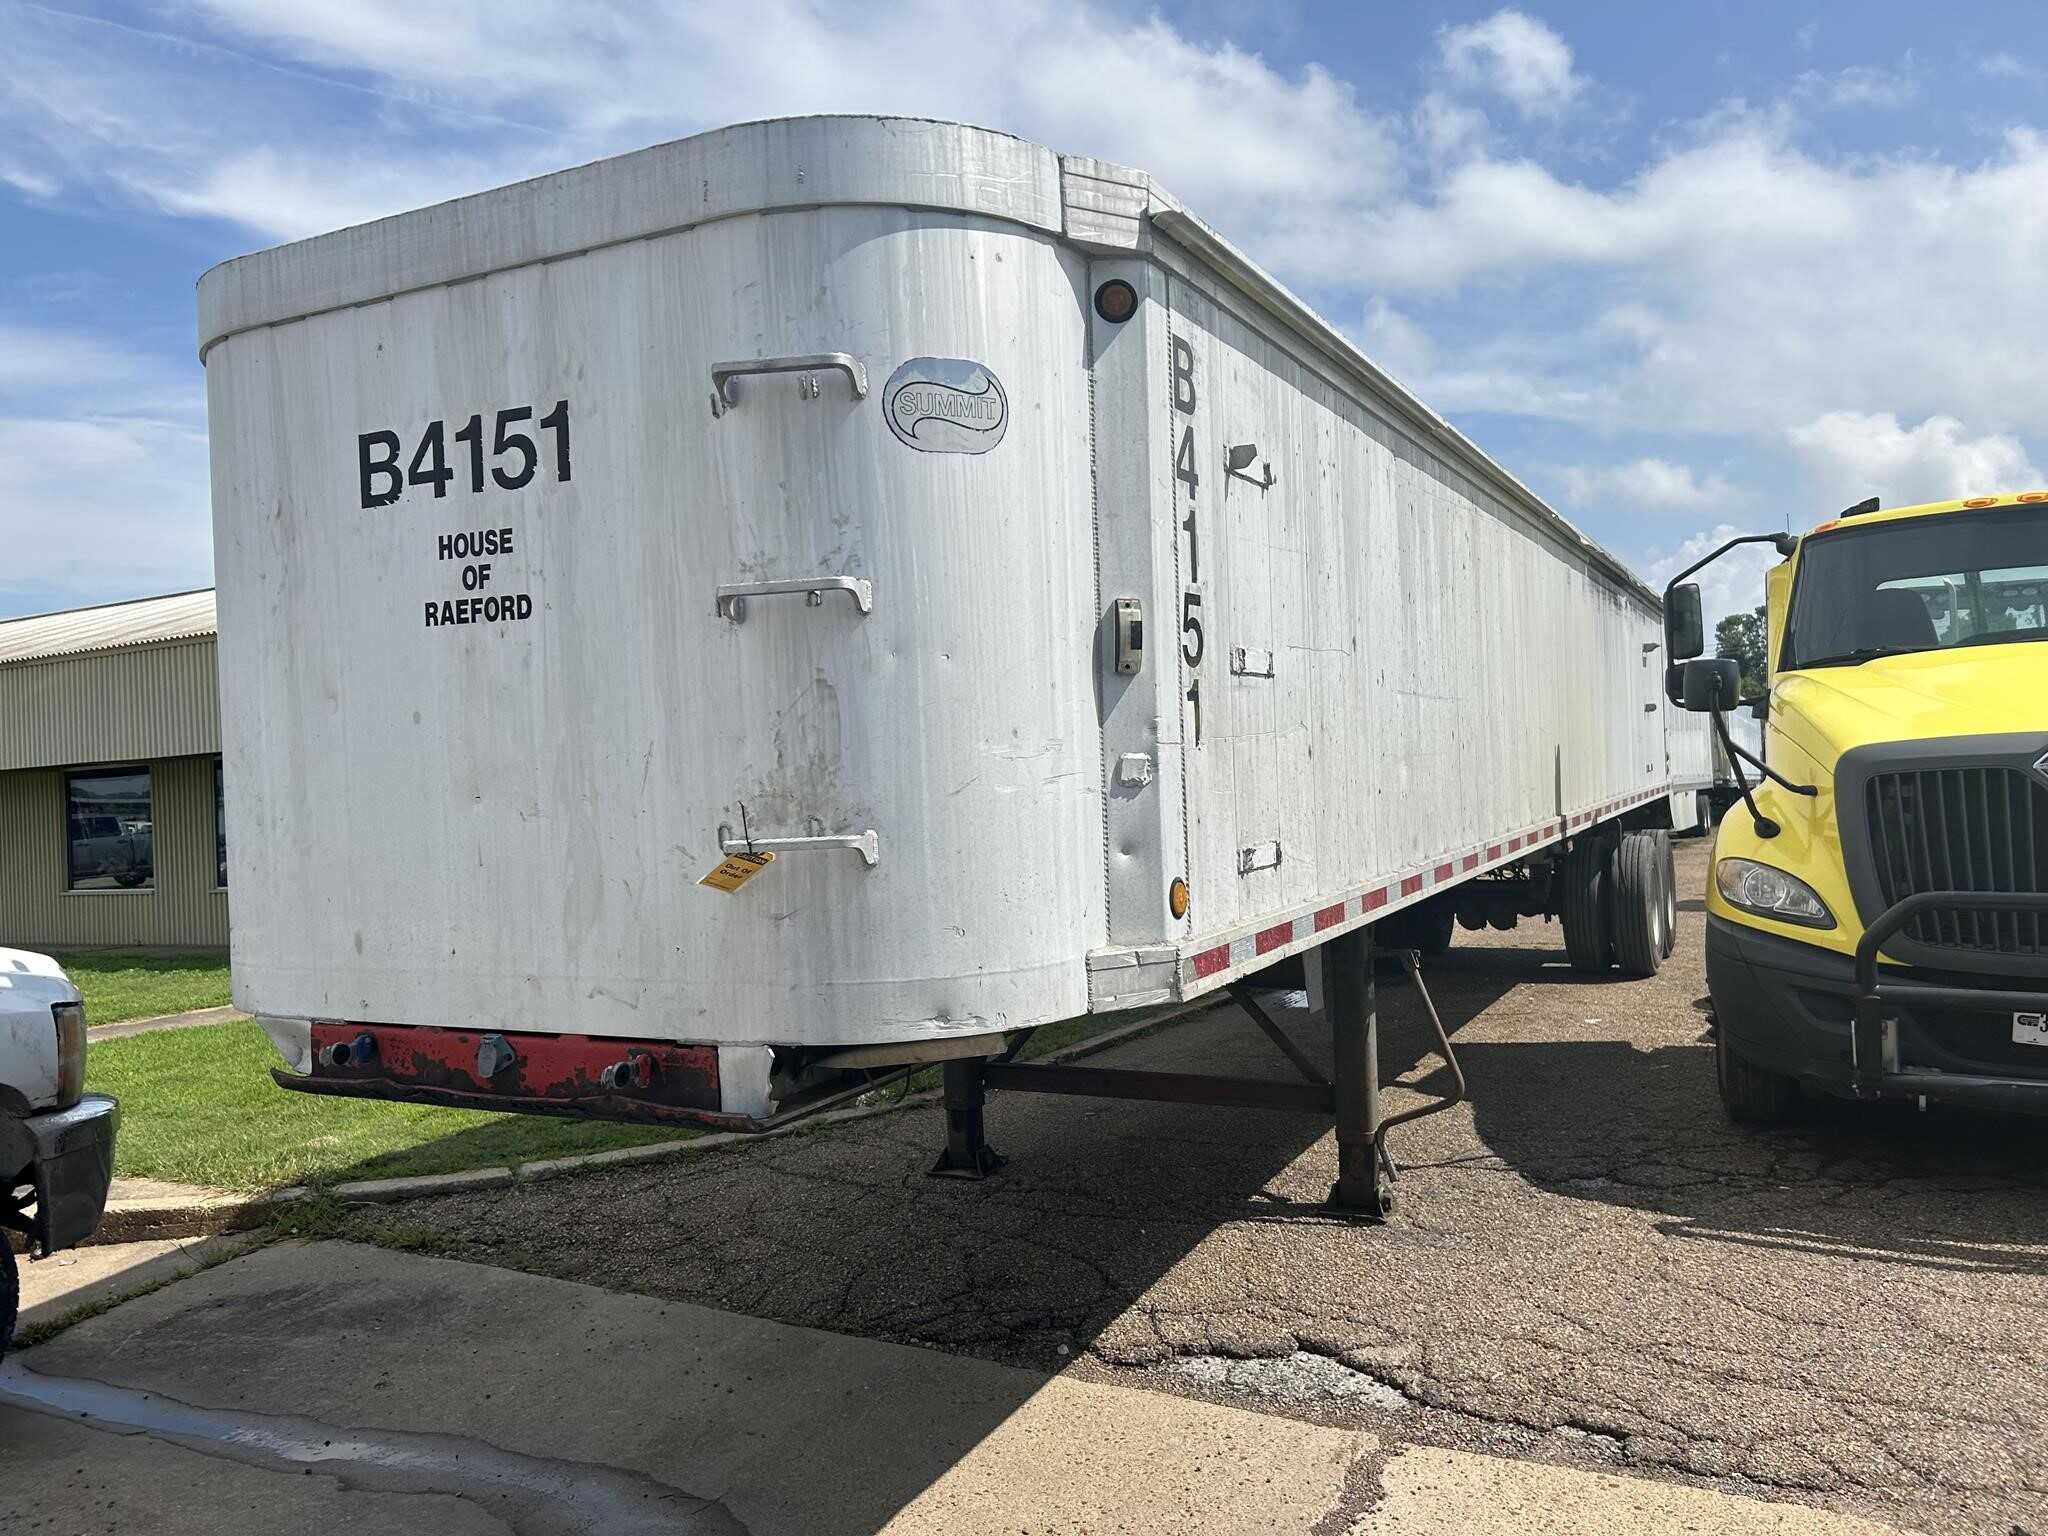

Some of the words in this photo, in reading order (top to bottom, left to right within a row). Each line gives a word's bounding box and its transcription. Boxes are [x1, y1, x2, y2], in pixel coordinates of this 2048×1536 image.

[900, 391, 997, 420] SUMMIT
[358, 400, 572, 509] B4151
[438, 528, 513, 560] HOUSE
[1172, 333, 1205, 748] B4151
[462, 564, 491, 591] OF
[425, 594, 532, 627] RAEFORD
